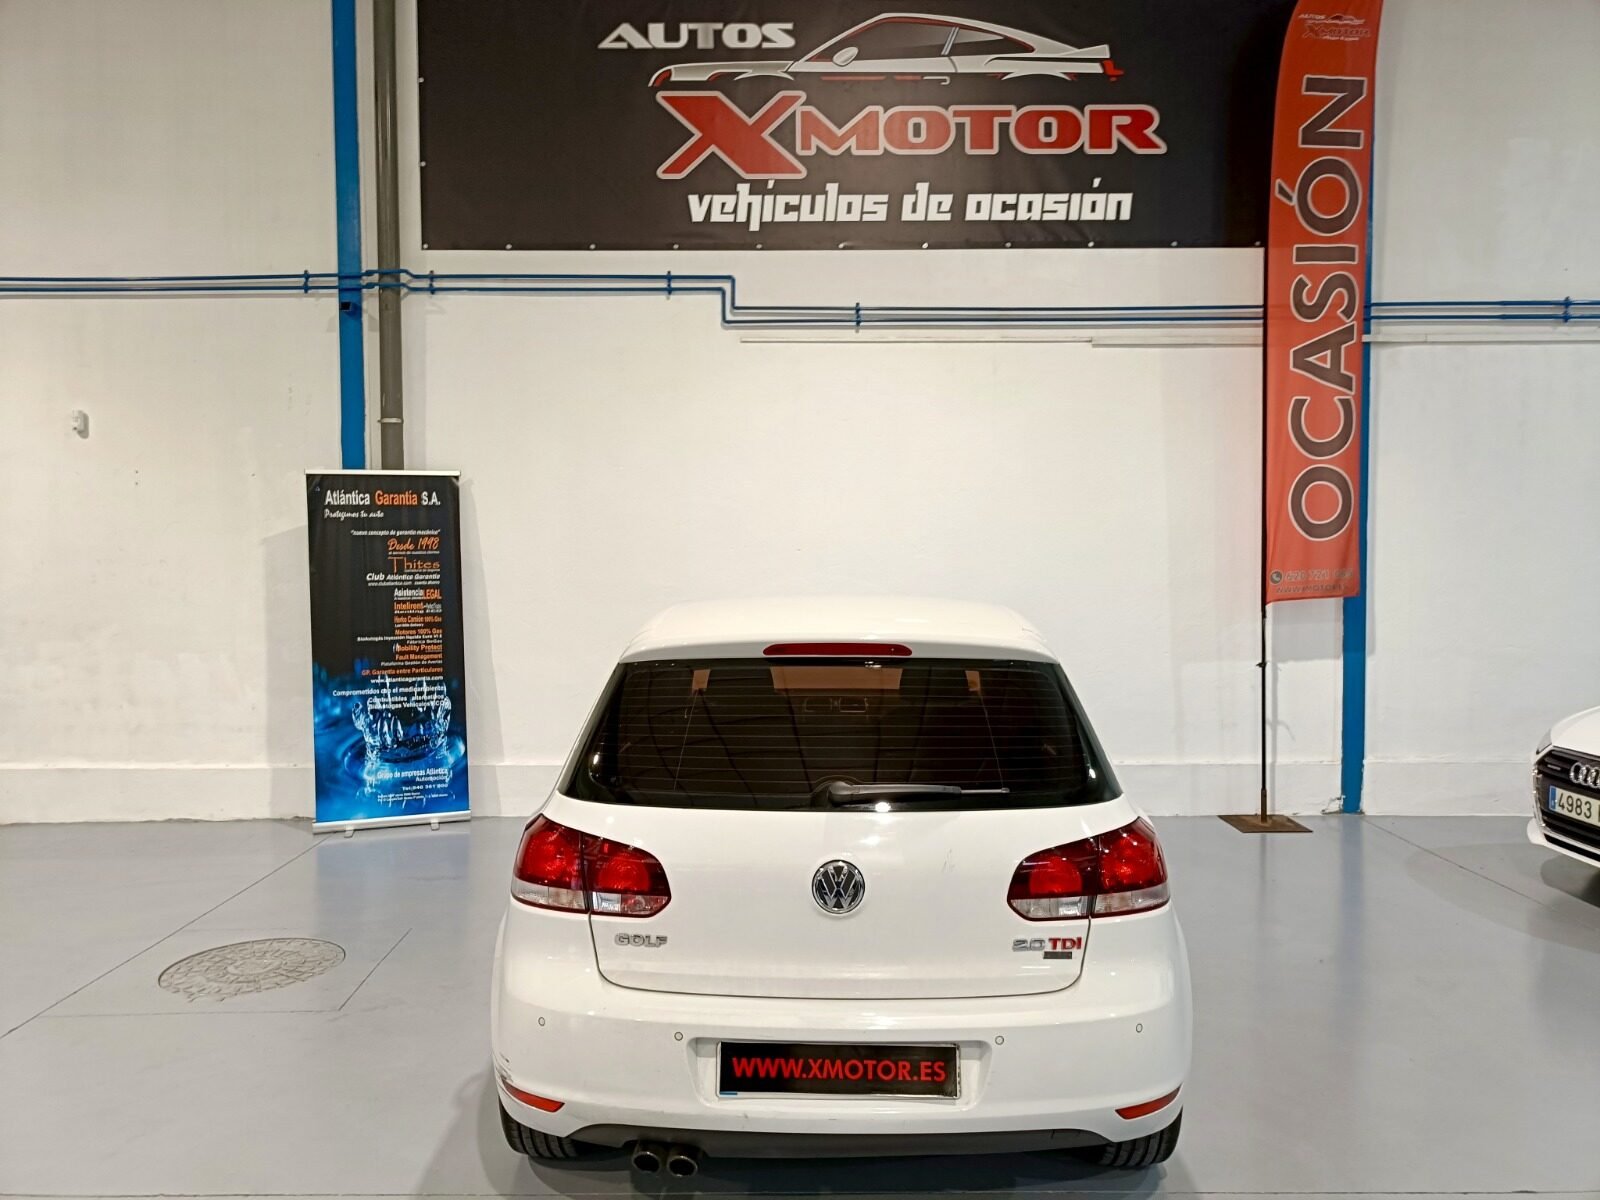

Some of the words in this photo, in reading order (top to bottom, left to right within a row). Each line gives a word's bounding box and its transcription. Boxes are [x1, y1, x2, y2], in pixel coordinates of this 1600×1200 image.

[598, 22, 795, 50] AUTOS
[656, 90, 1168, 180] XMOTOR
[687, 179, 889, 232] vehículos
[901, 182, 953, 223] de
[965, 178, 1134, 222] ocasión
[1275, 74, 1368, 542] OCASIÓN
[324, 489, 371, 505] Atlántica
[375, 490, 418, 505] Garantía
[421, 491, 441, 505] S.A.
[388, 538, 415, 550] Desde
[418, 536, 440, 550] 1998
[366, 572, 384, 581] Club
[332, 689, 380, 697] Comprometidos
[1558, 792, 1592, 819] 4983
[614, 932, 668, 948] GOLF
[732, 1057, 946, 1082] WWW.XMOTOR.ES
